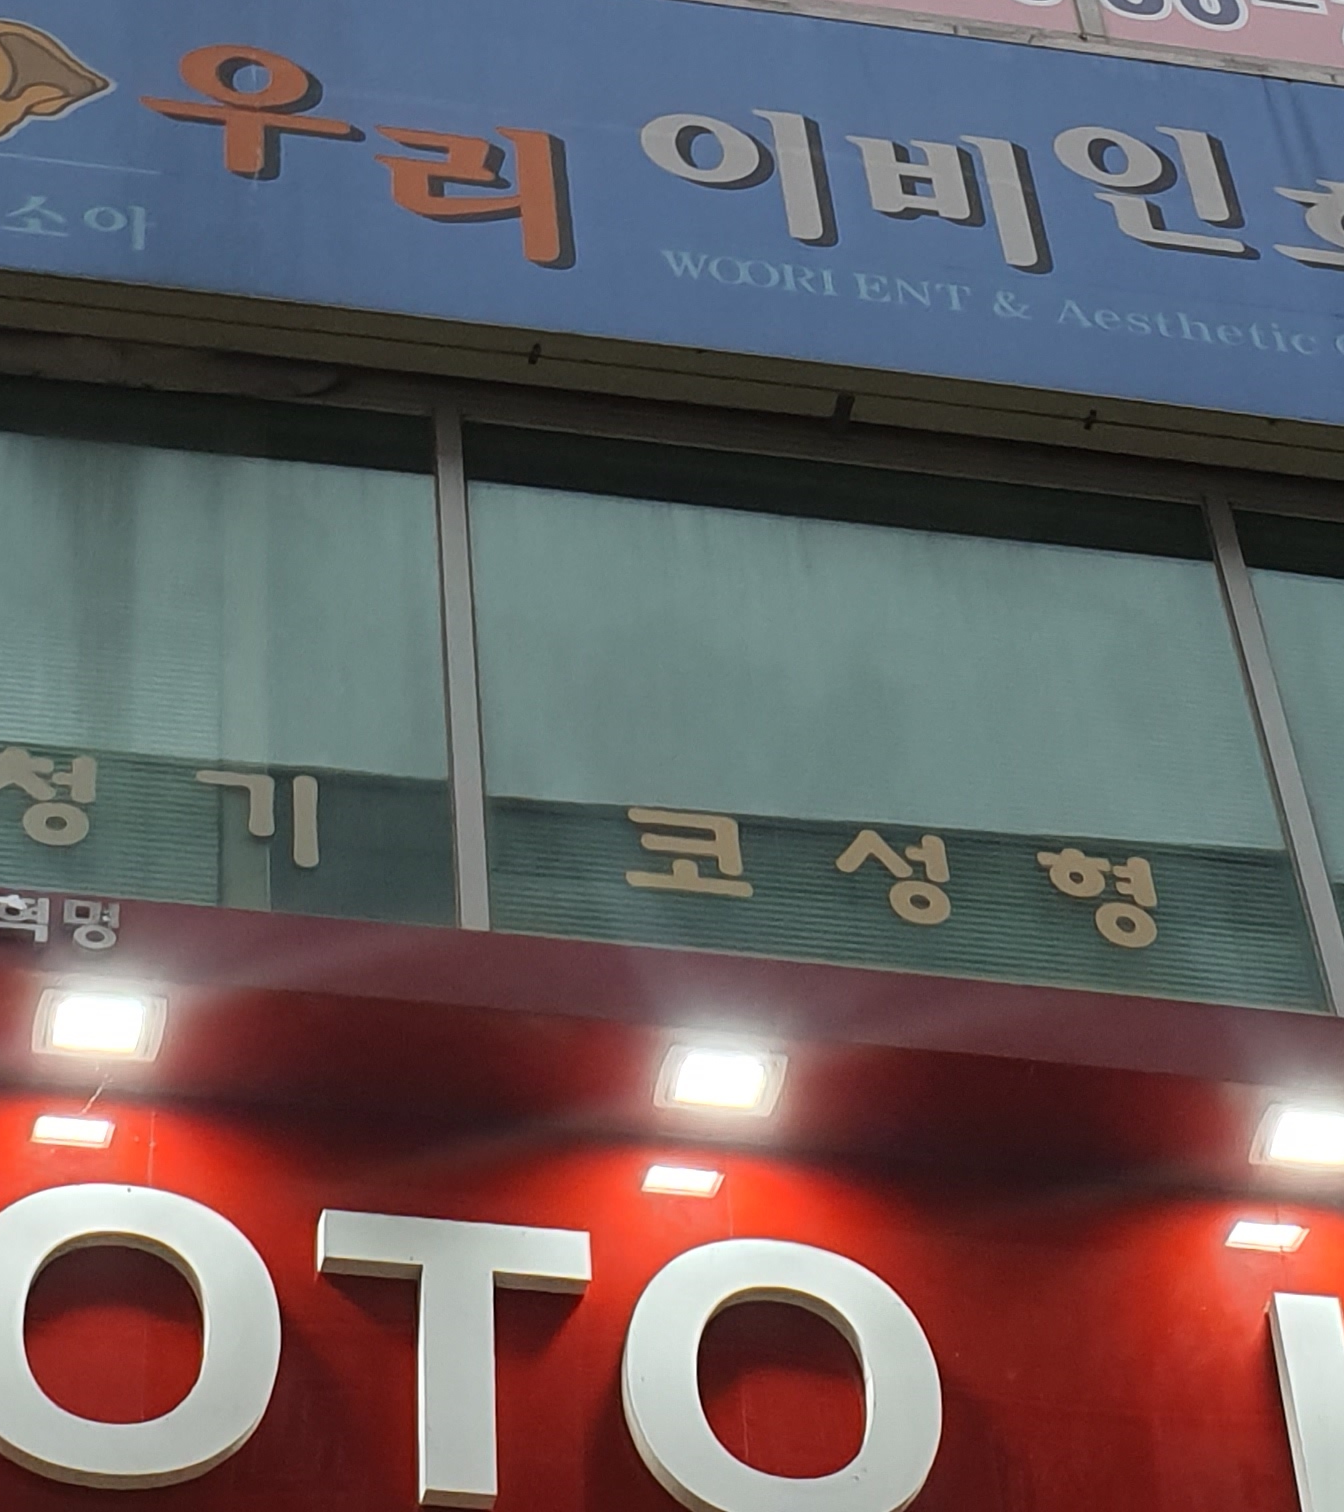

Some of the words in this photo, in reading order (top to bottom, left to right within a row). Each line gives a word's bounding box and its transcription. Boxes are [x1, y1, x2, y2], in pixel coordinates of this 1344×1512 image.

[138, 43, 577, 270] 우리
[660, 249, 839, 300] WOORI
[857, 271, 974, 314] ENT
[992, 289, 1036, 323] &
[1056, 297, 1321, 358] Aesthetic
